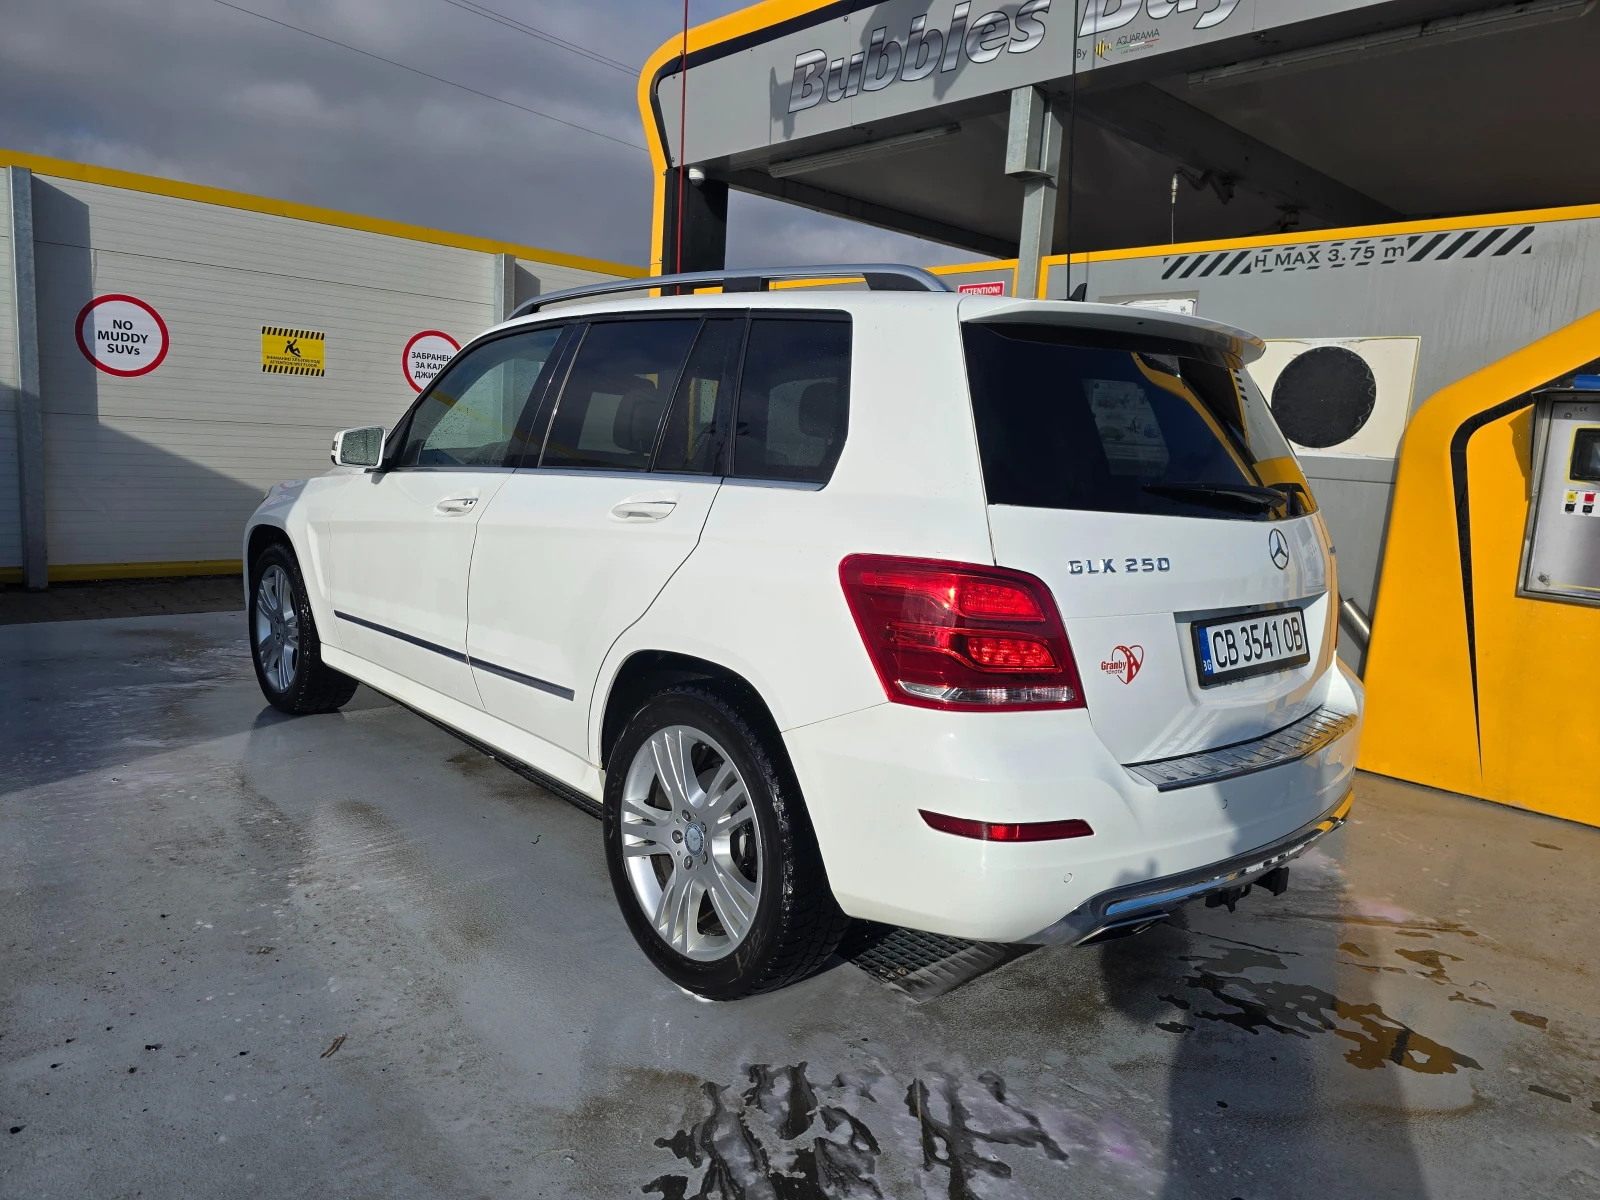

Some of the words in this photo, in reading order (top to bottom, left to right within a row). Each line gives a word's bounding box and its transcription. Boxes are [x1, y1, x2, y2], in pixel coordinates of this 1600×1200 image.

[1115, 28, 1160, 46] AQUARAMA
[787, 0, 1050, 114] Bubbles
[1076, 48, 1087, 60] By
[1254, 254, 1267, 268] H
[1274, 250, 1321, 266] MAX
[1327, 246, 1375, 262] 3.75
[1384, 245, 1405, 258] m
[961, 285, 1001, 295] ATTENTION!
[112, 319, 133, 330] NO
[97, 330, 148, 344] MUDDY
[107, 343, 140, 355] SUVs
[415, 361, 426, 369] ЗА
[426, 362, 445, 371] КАЛ
[1067, 558, 1117, 575] GLK
[1124, 556, 1171, 573] 250
[1212, 628, 1239, 668] CB
[1240, 619, 1282, 662] 3541
[1101, 660, 1127, 671] Granby
